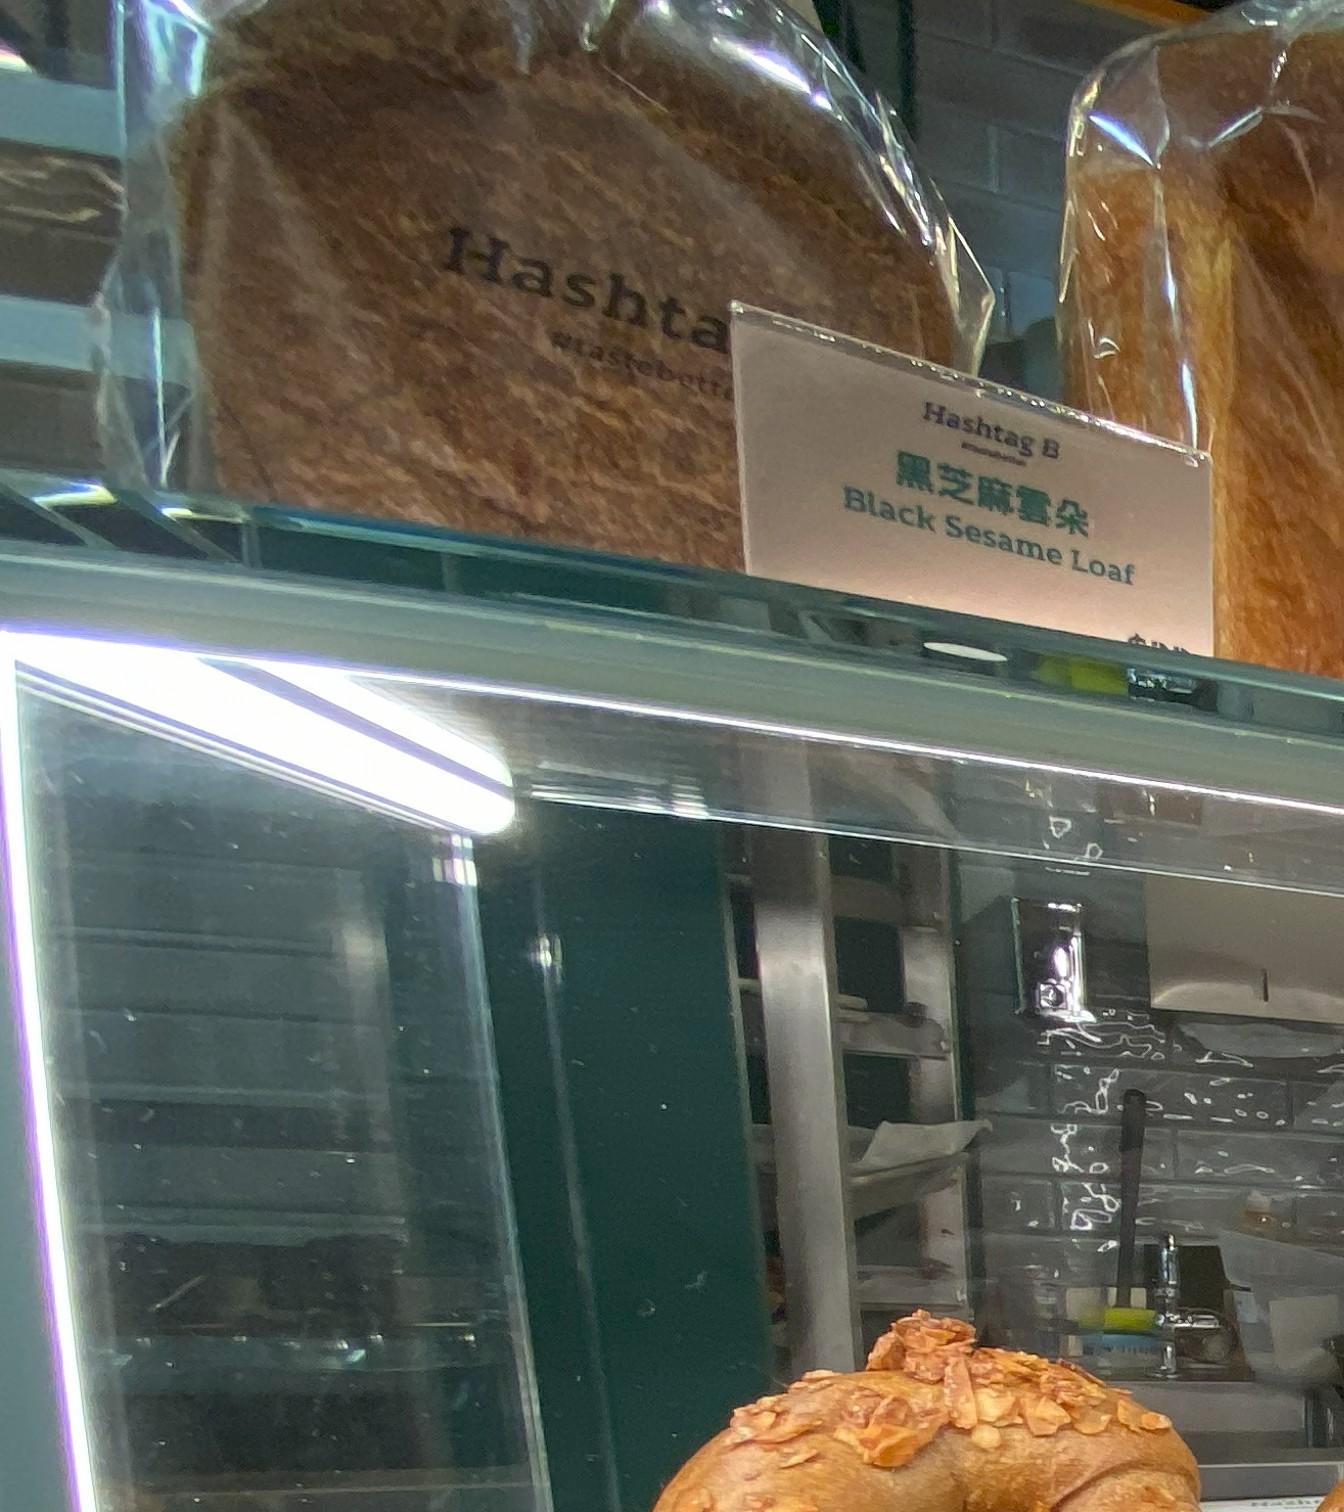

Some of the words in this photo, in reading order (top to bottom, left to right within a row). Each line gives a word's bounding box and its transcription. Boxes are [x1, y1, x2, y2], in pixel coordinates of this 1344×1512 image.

[447, 227, 731, 354] Hashta
[552, 330, 734, 400] #tastebett
[923, 402, 1036, 456] Hashtag
[1042, 437, 1060, 460] B
[843, 486, 936, 532] Black
[945, 514, 1062, 566] Sesame
[1071, 549, 1136, 586] Loaf
[896, 450, 1089, 537] 黑芝麻雲朵
